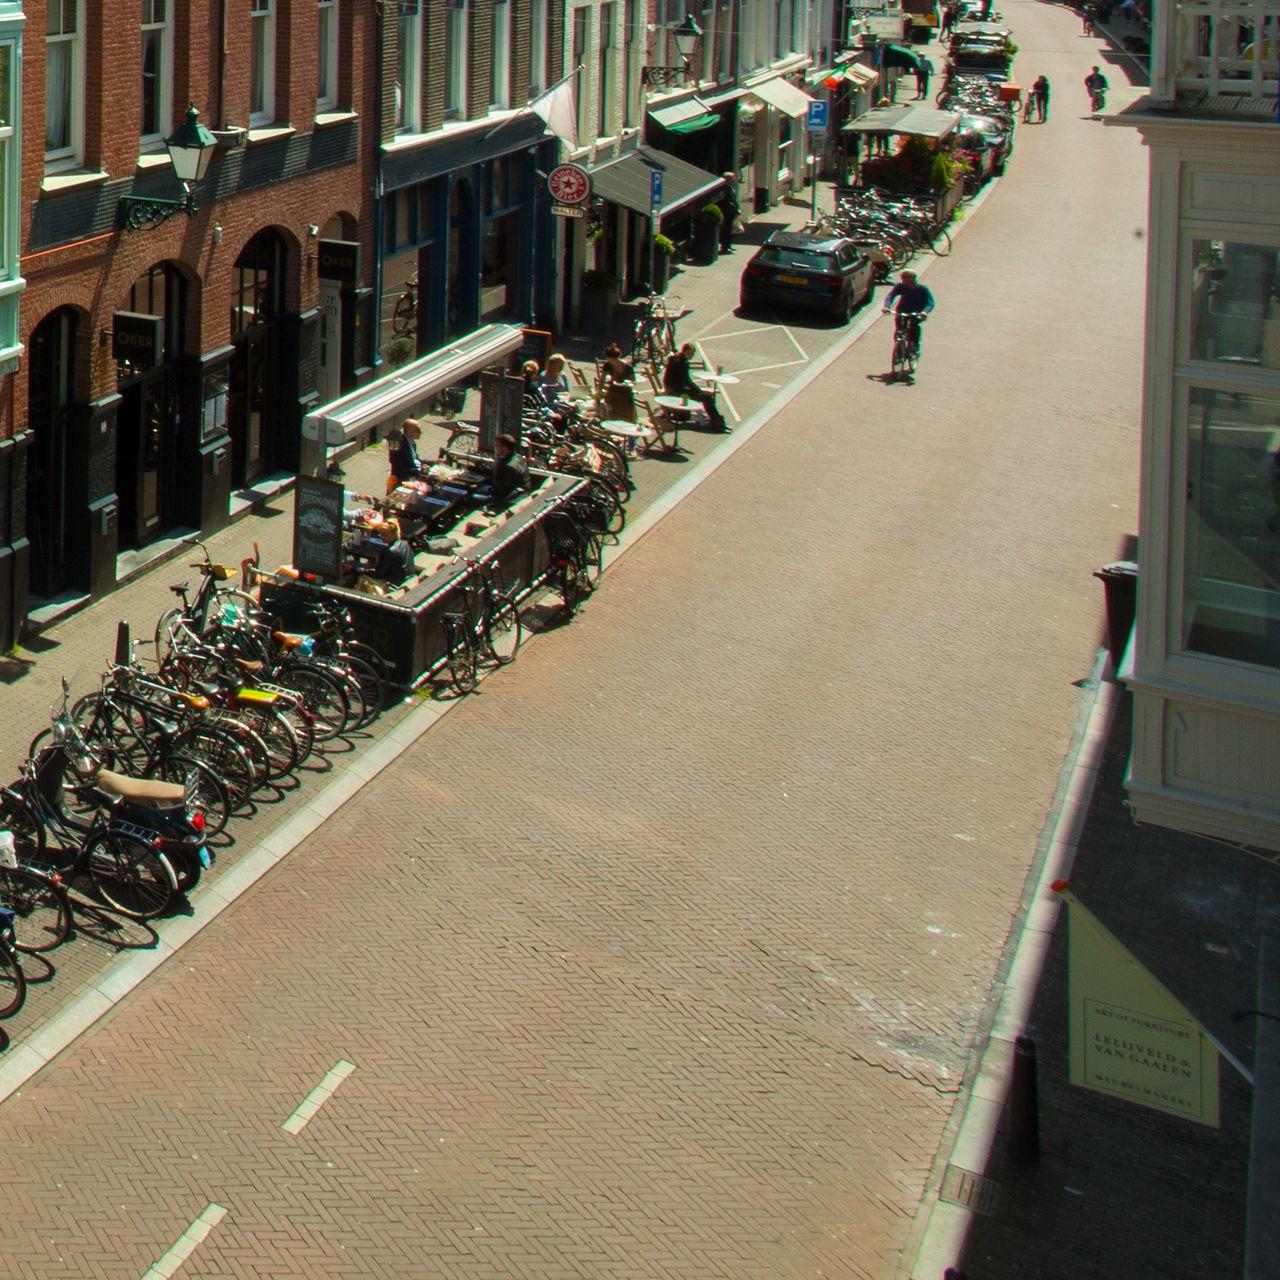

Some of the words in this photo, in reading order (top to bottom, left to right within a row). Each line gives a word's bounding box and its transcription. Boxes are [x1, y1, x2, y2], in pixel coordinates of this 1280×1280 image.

[811, 102, 824, 115] P
[551, 169, 584, 190] Heineken
[556, 190, 579, 200] Bier
[554, 207, 581, 217] WALTER
[119, 332, 154, 348] OKER
[1094, 1044, 1125, 1058] VAN
[1129, 1053, 1191, 1079] GAALEN
